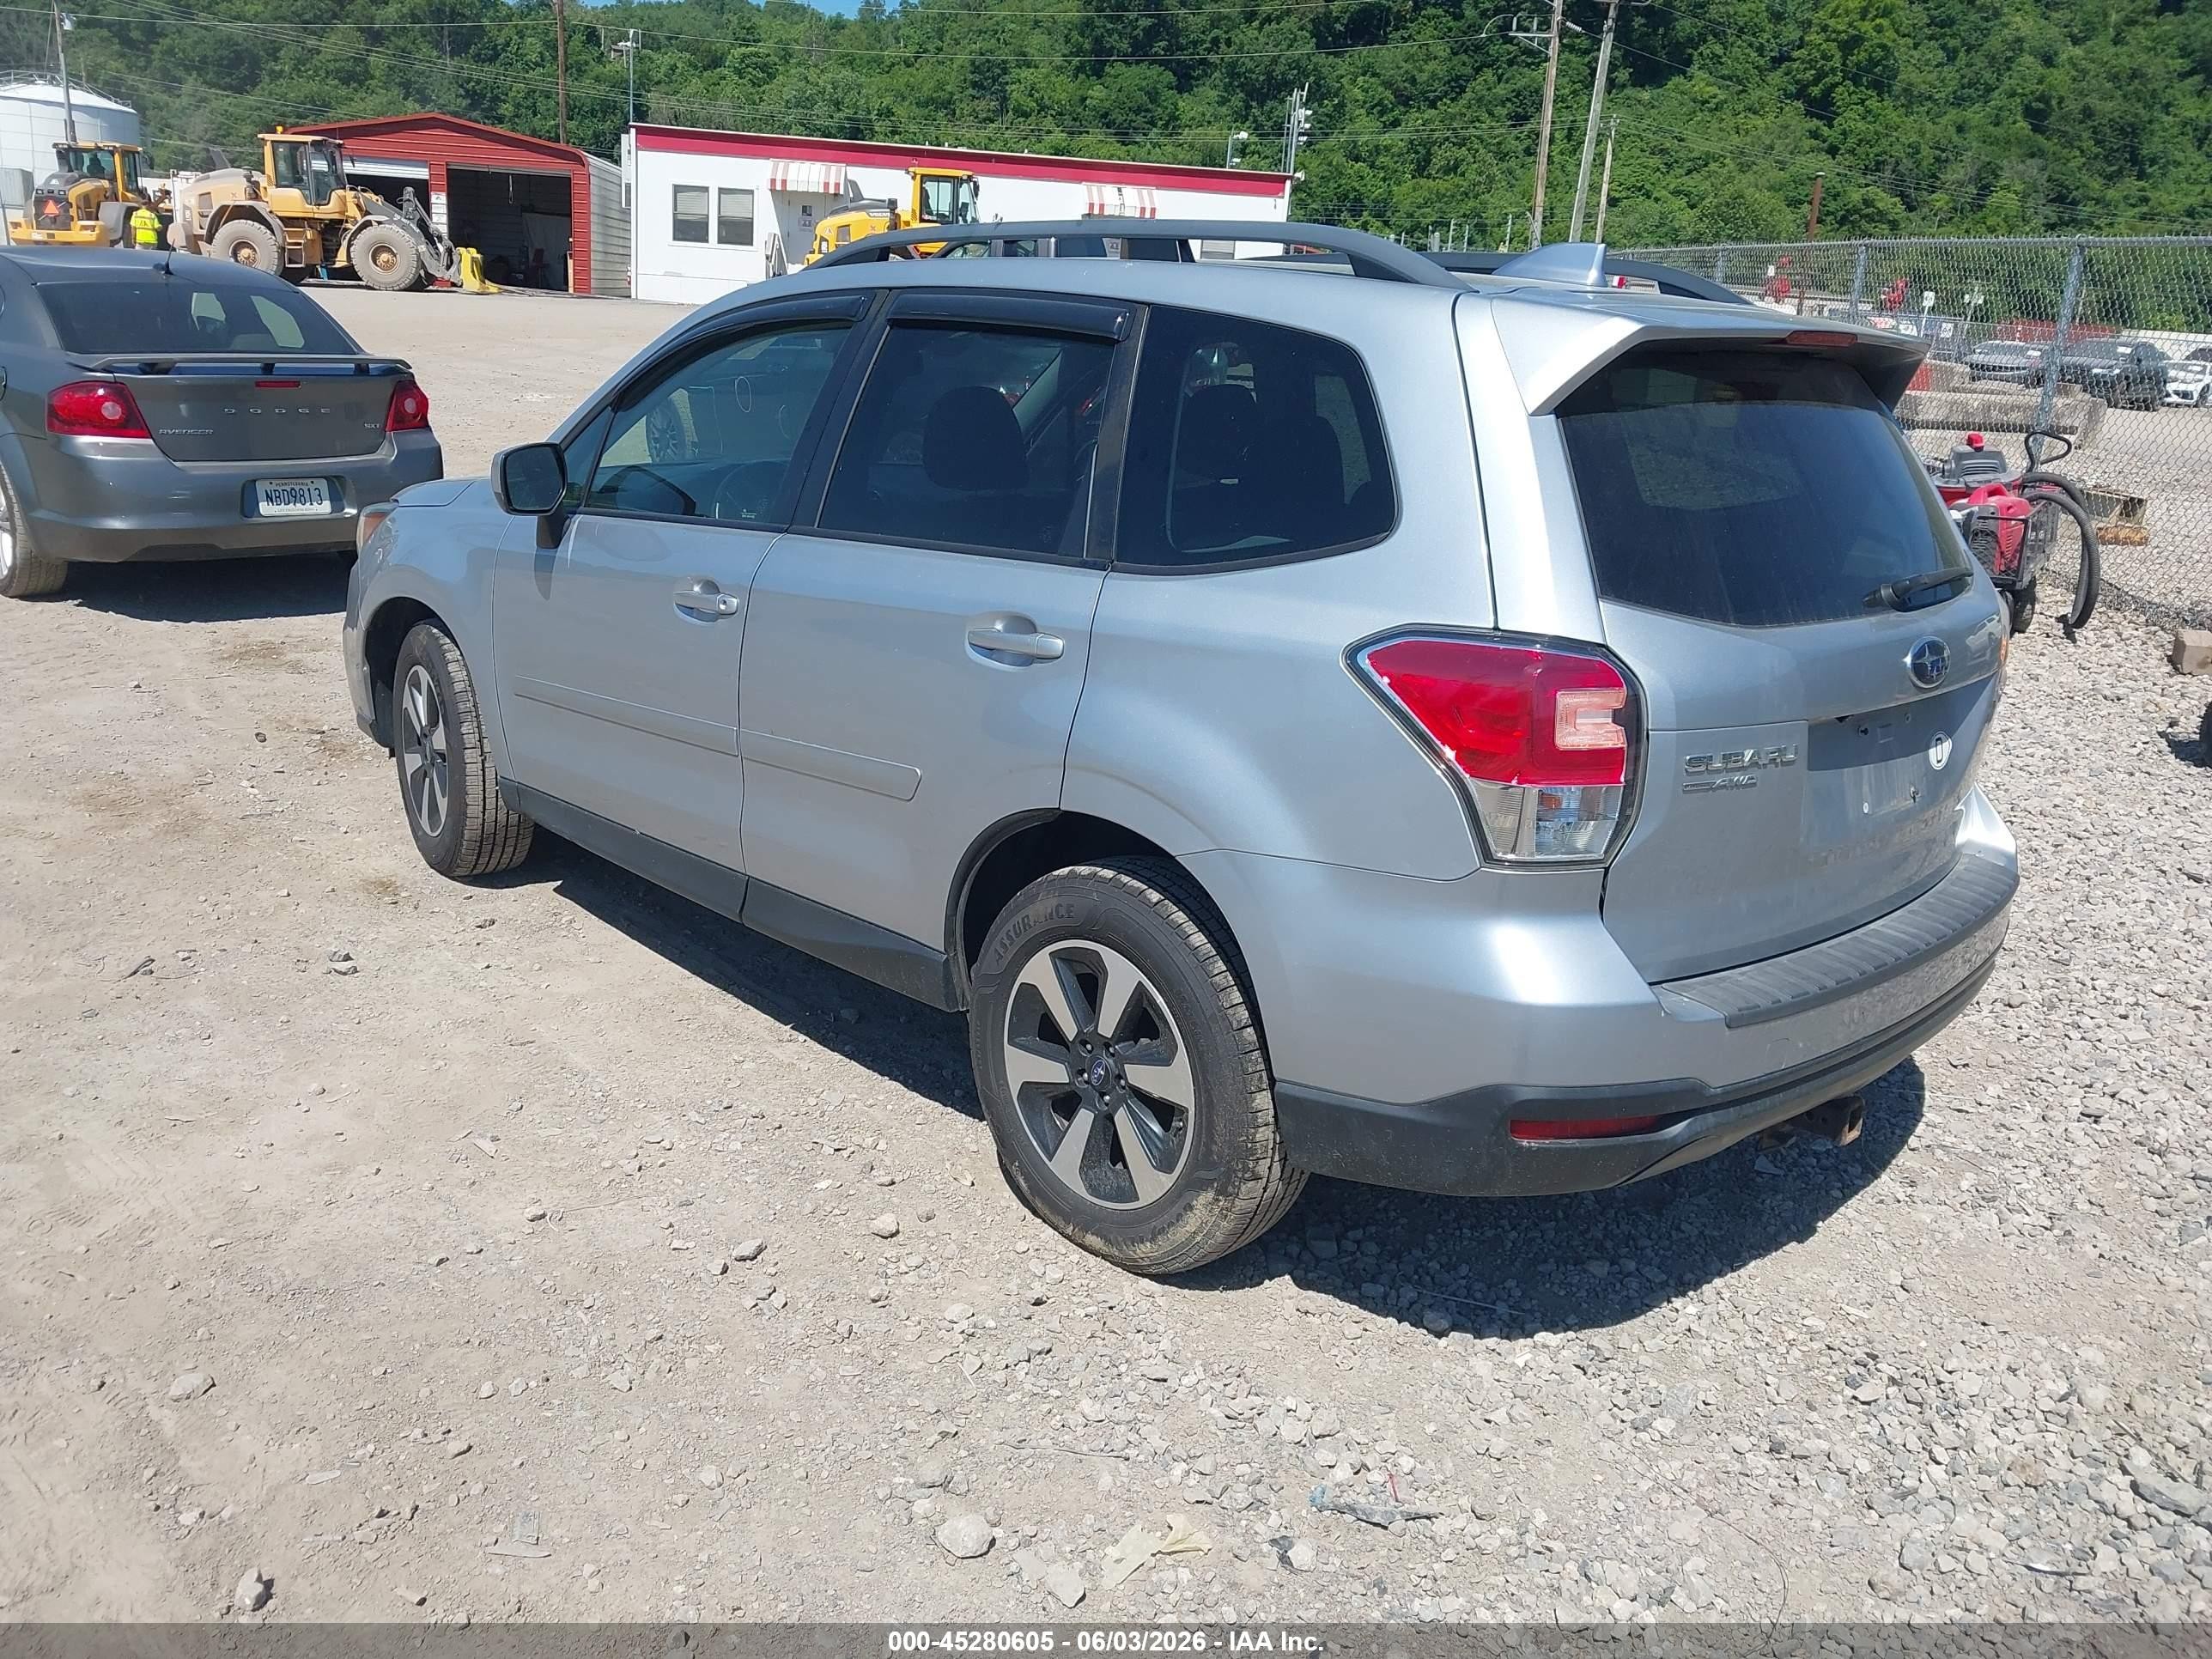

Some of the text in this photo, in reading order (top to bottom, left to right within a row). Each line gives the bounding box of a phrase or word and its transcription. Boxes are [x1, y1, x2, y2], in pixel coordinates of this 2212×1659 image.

[223, 407, 331, 416] DODGE
[264, 487, 324, 507] NBD9813
[1684, 743, 1800, 775] SUBARU
[994, 902, 1075, 966] ASSURANCE
